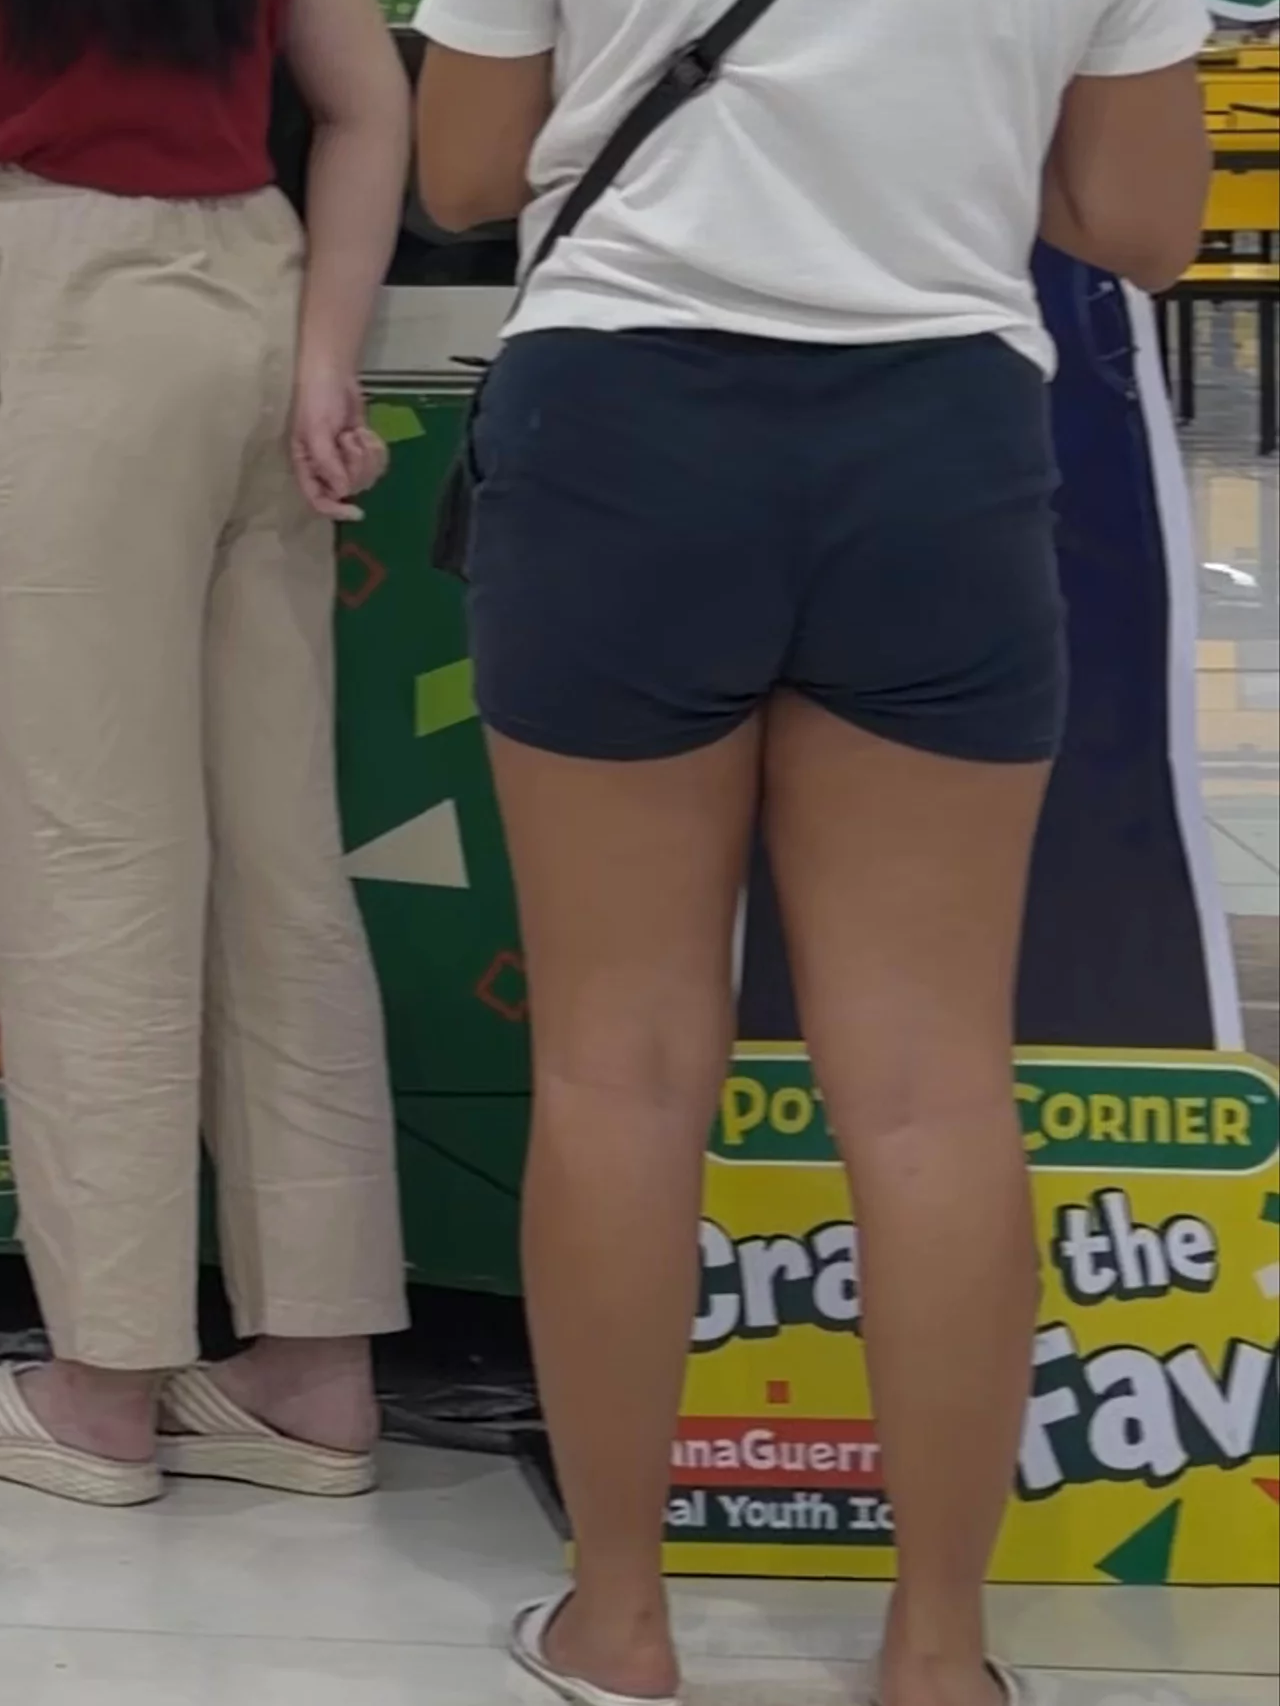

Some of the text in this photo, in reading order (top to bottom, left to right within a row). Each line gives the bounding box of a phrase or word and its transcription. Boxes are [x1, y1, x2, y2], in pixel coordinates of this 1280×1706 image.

[1056, 1189, 1218, 1296] the
[662, 1489, 708, 1528] al
[717, 1491, 839, 1530] Youth
